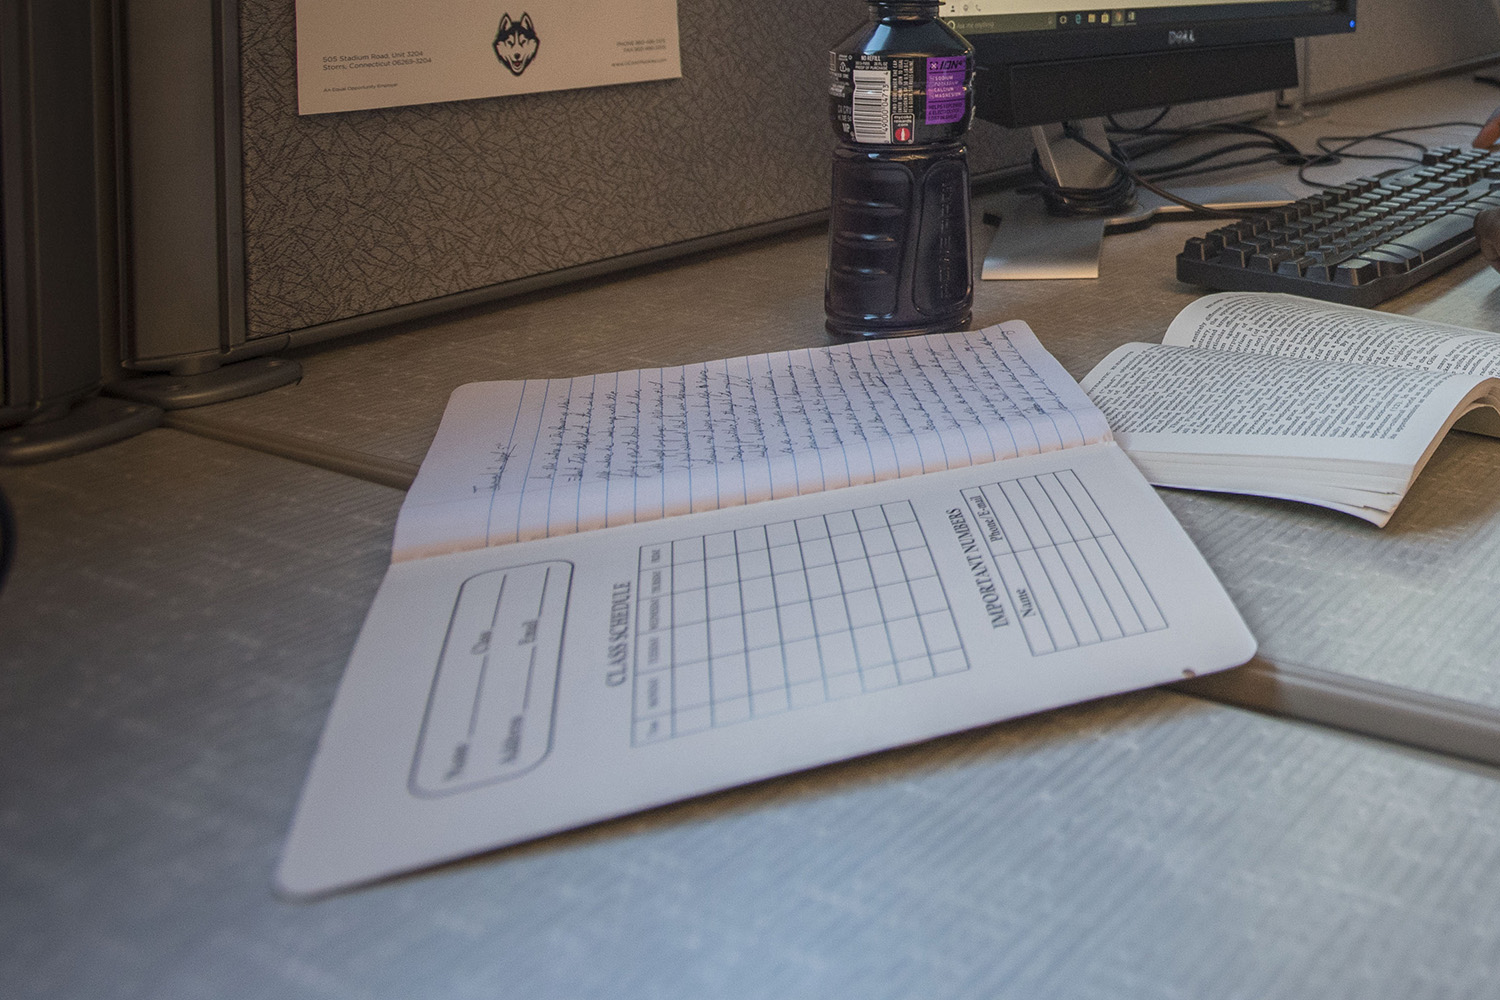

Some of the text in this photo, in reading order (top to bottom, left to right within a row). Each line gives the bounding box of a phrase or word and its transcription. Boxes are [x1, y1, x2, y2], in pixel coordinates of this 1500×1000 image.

[340, 54, 370, 62] Stadium
[349, 60, 391, 69] Connecticut
[1168, 30, 1196, 44] DELL
[943, 506, 1011, 630] IMPORTANT NUMBERS
[966, 493, 1039, 619] Name Phone/E-mail
[604, 580, 632, 688] CLASS SCHEDULE
